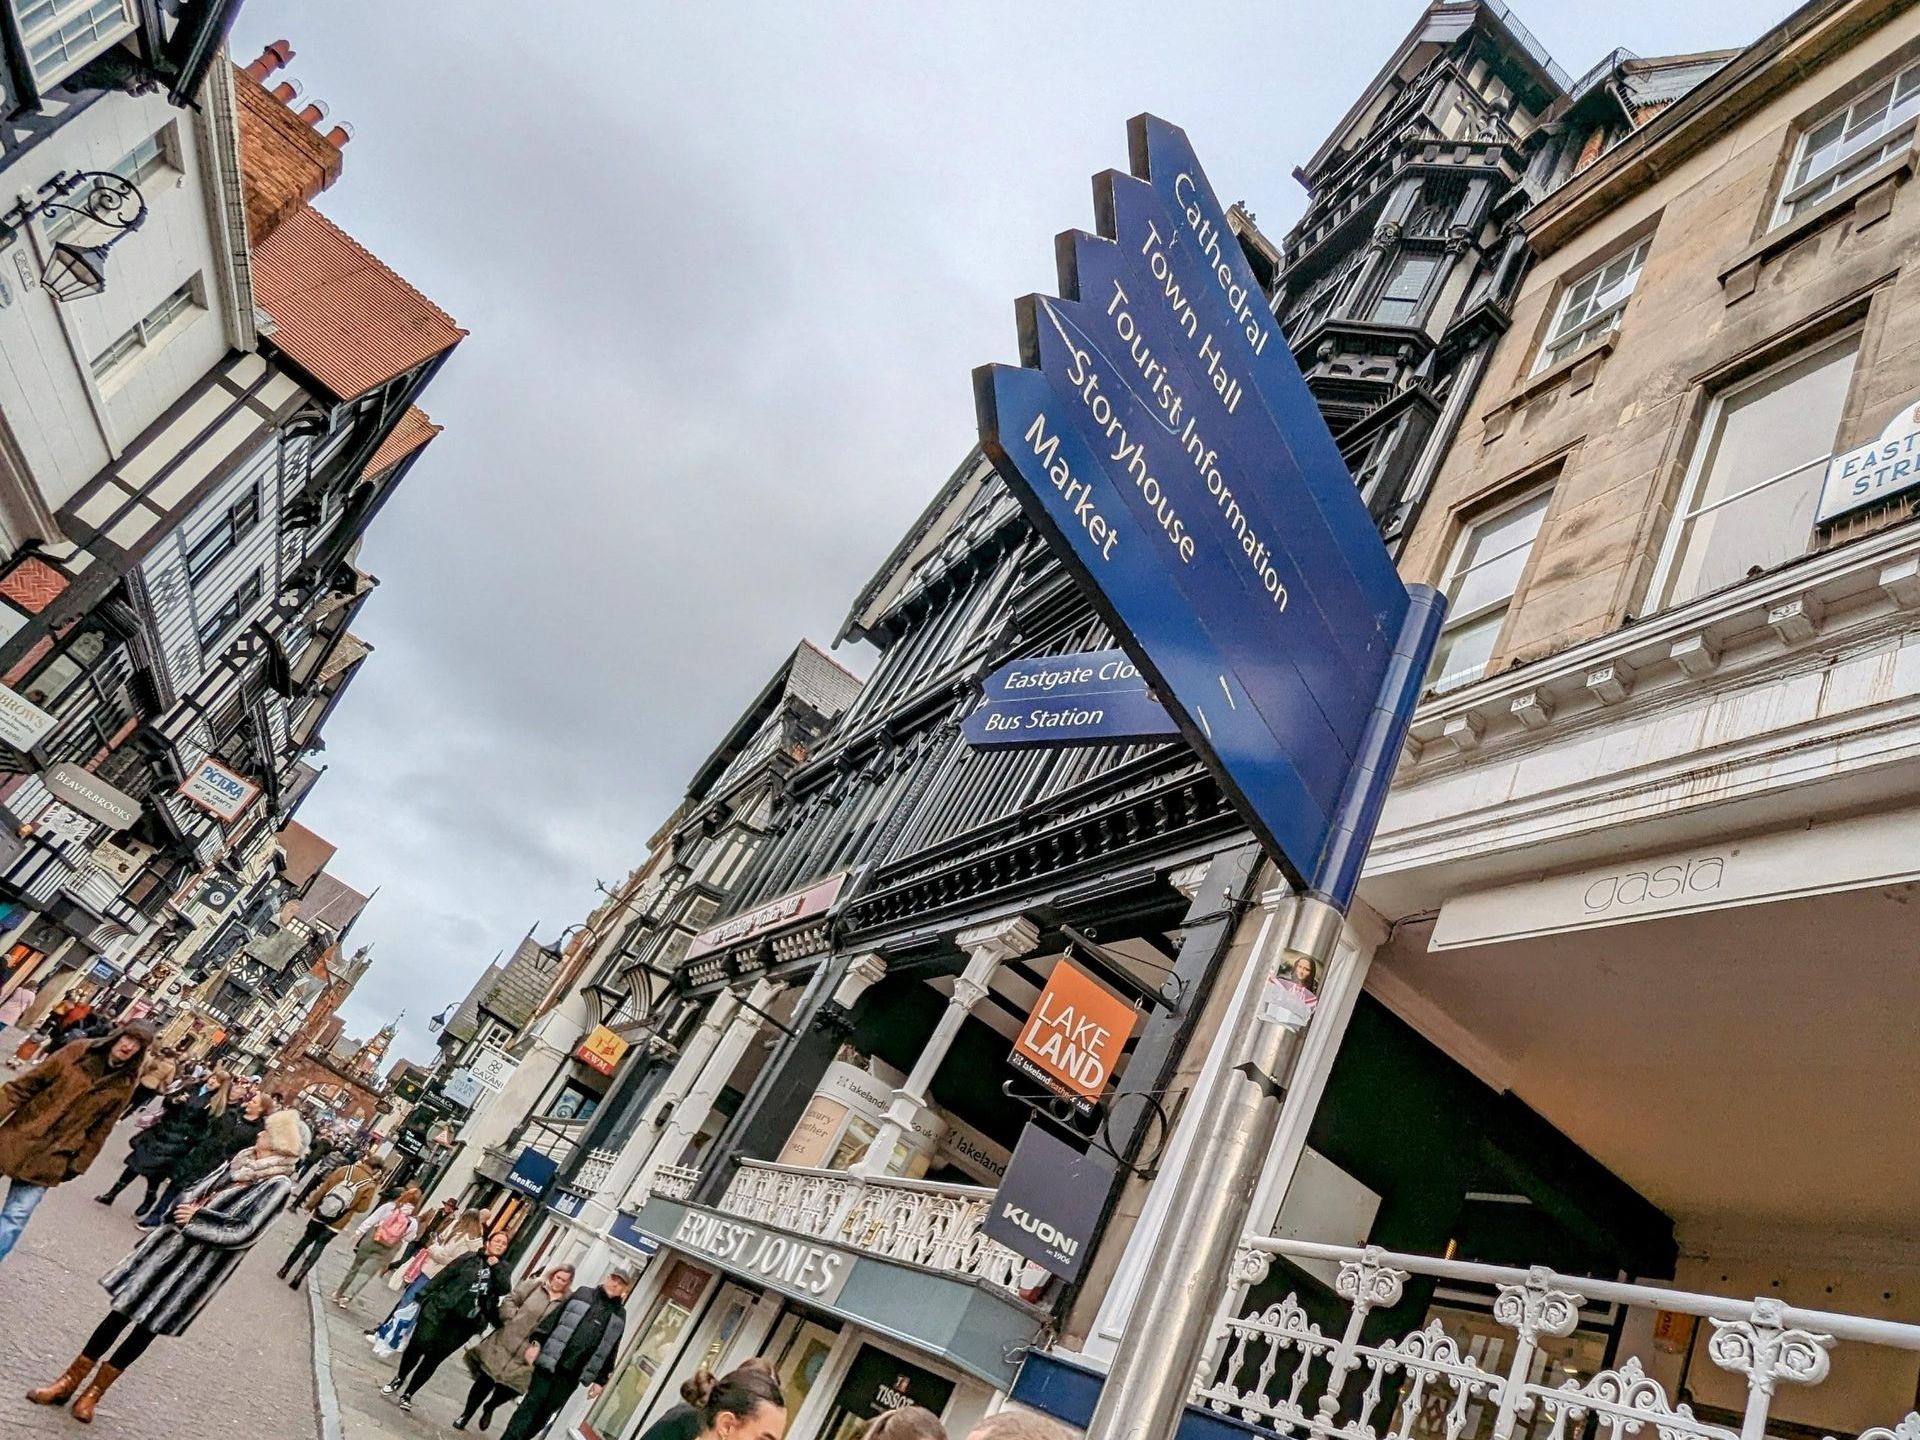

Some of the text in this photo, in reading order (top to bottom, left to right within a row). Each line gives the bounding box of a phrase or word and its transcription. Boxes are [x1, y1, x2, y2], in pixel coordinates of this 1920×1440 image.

[1174, 172, 1269, 356] Cathedral
[1140, 220, 1243, 414] Town Hall
[1066, 348, 1196, 564] Storyhouse
[1105, 279, 1290, 613] Tourist Information
[1842, 430, 1920, 479] EAST
[1024, 413, 1119, 561] Market
[1003, 666, 1093, 690] Eastgate
[984, 707, 1103, 731] Bus Station
[54, 770, 131, 822] BEAVERBROOKS
[1037, 991, 1110, 1059] LAKE
[471, 1067, 504, 1088] CAVANI
[583, 1050, 610, 1071] EWM
[1023, 1019, 1103, 1086] LAND
[509, 1171, 543, 1193] MenKind
[956, 1136, 1005, 1177] lakeland
[675, 1211, 841, 1294] ERNEST JONES
[1001, 1202, 1079, 1256] KUONI
[1053, 1251, 1071, 1264] 1906
